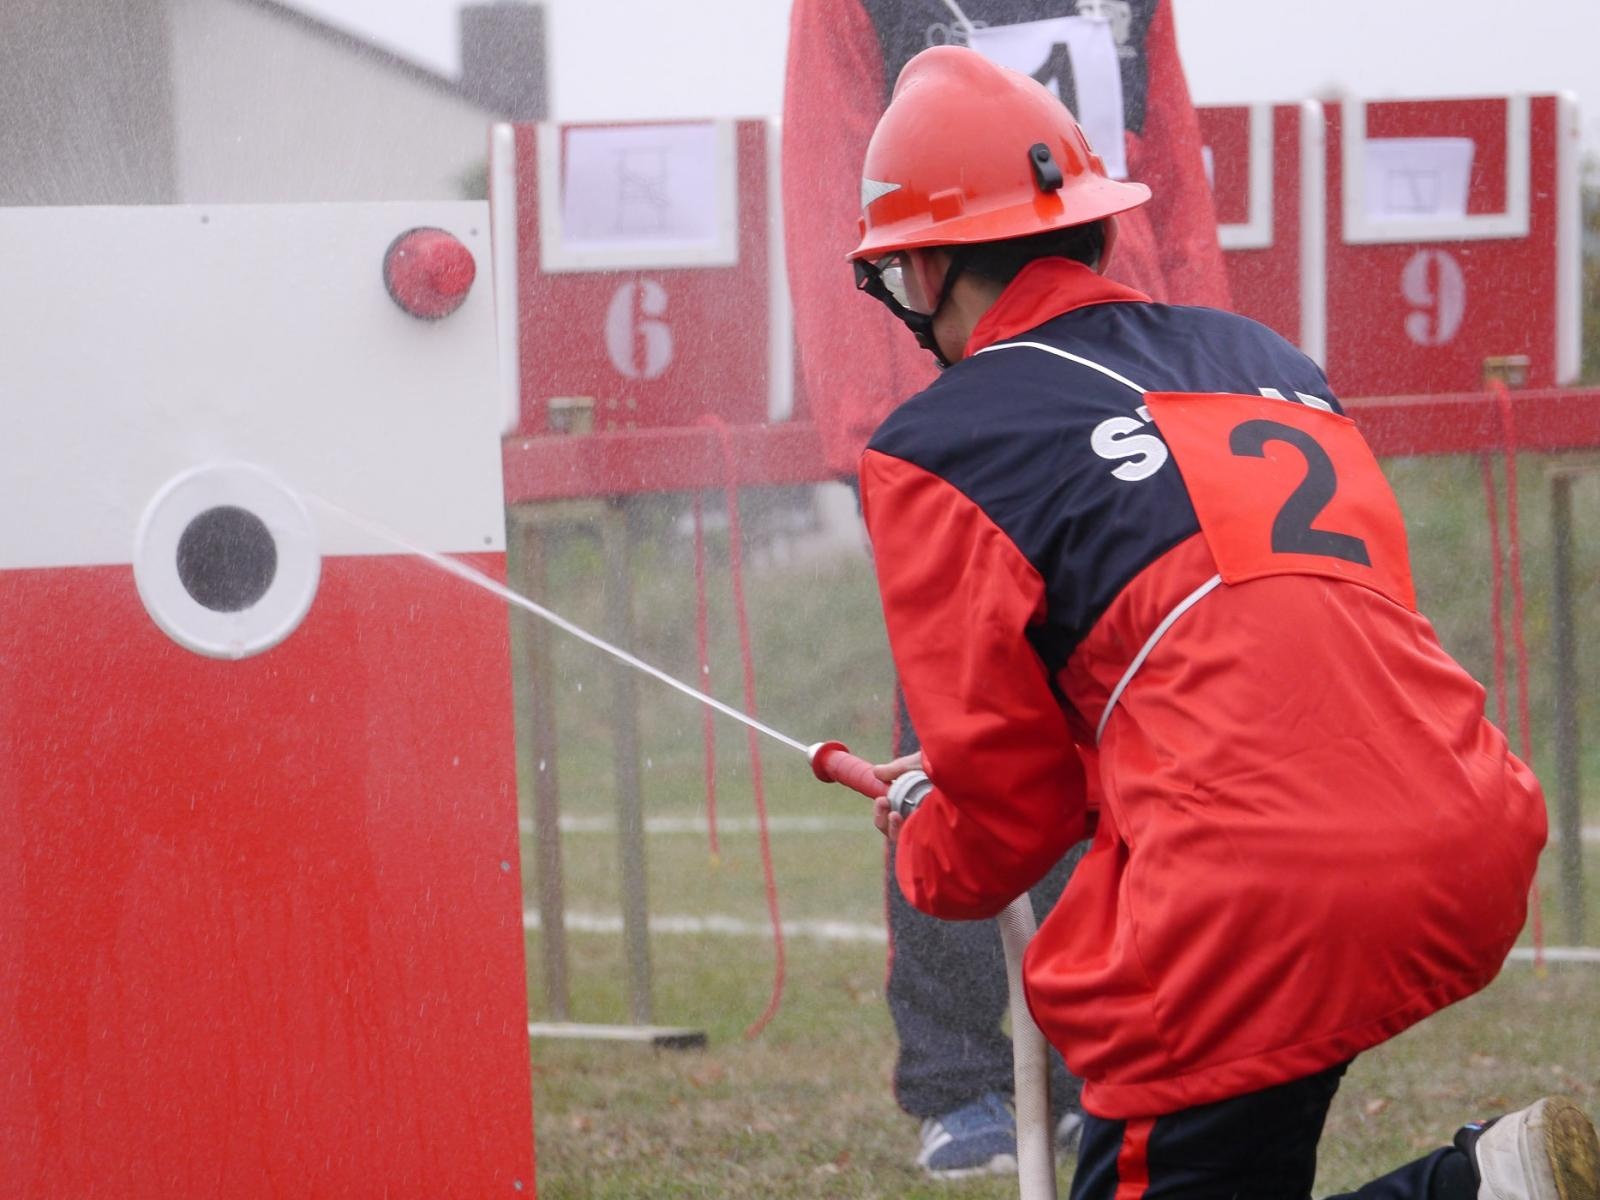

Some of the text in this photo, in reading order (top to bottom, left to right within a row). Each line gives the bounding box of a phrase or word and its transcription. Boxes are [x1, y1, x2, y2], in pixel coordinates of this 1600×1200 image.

[604, 278, 674, 380] 6
[1400, 249, 1466, 346] 9
[1228, 419, 1373, 568] 2
